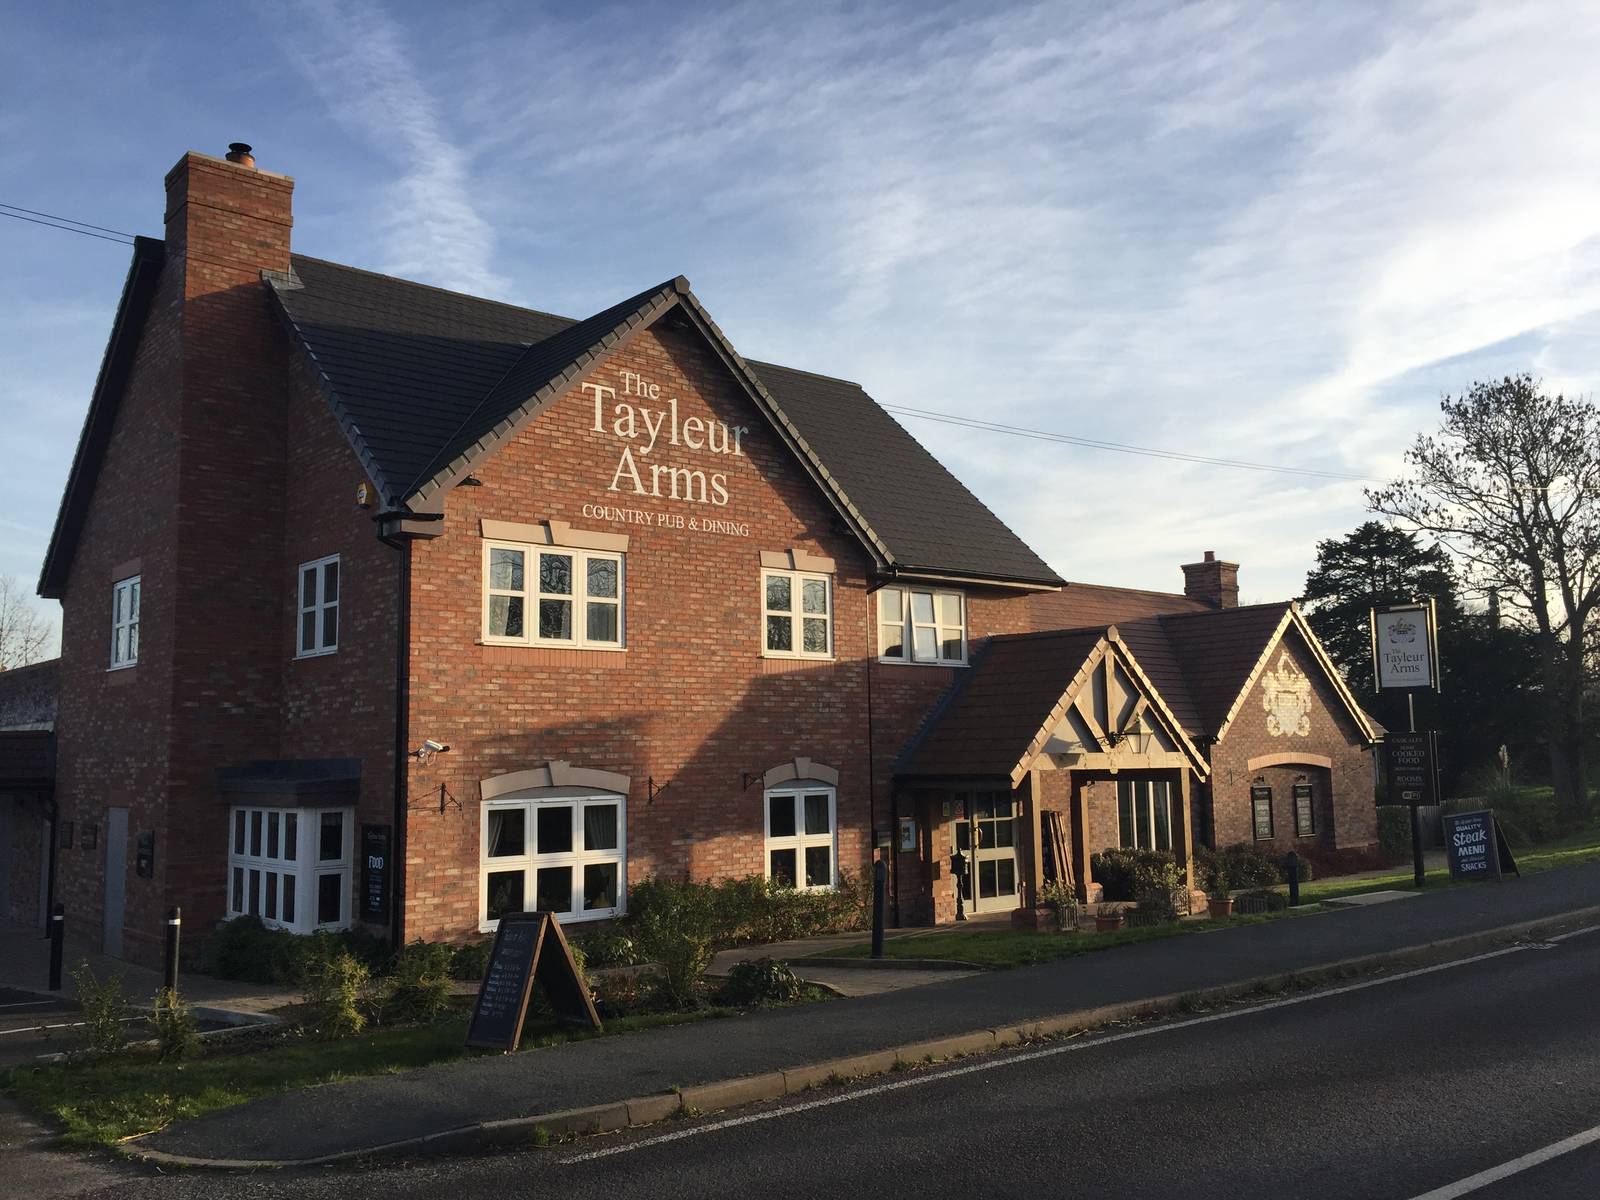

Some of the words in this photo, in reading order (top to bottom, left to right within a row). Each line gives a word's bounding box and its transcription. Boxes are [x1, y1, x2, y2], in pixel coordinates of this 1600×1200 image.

[619, 371, 661, 400] The
[581, 382, 749, 456] Tayleur
[607, 445, 729, 506] Arms
[582, 504, 656, 526] COUNTRY
[657, 513, 685, 529] PUB
[688, 518, 699, 531] &
[702, 519, 750, 537] DINING
[1383, 652, 1425, 665] Tayleur
[1390, 662, 1421, 674] Arms
[1455, 823, 1482, 832] QUALITY
[1452, 829, 1488, 847] Steak
[1458, 844, 1486, 857] MENU
[1460, 861, 1487, 872] SNACKS
